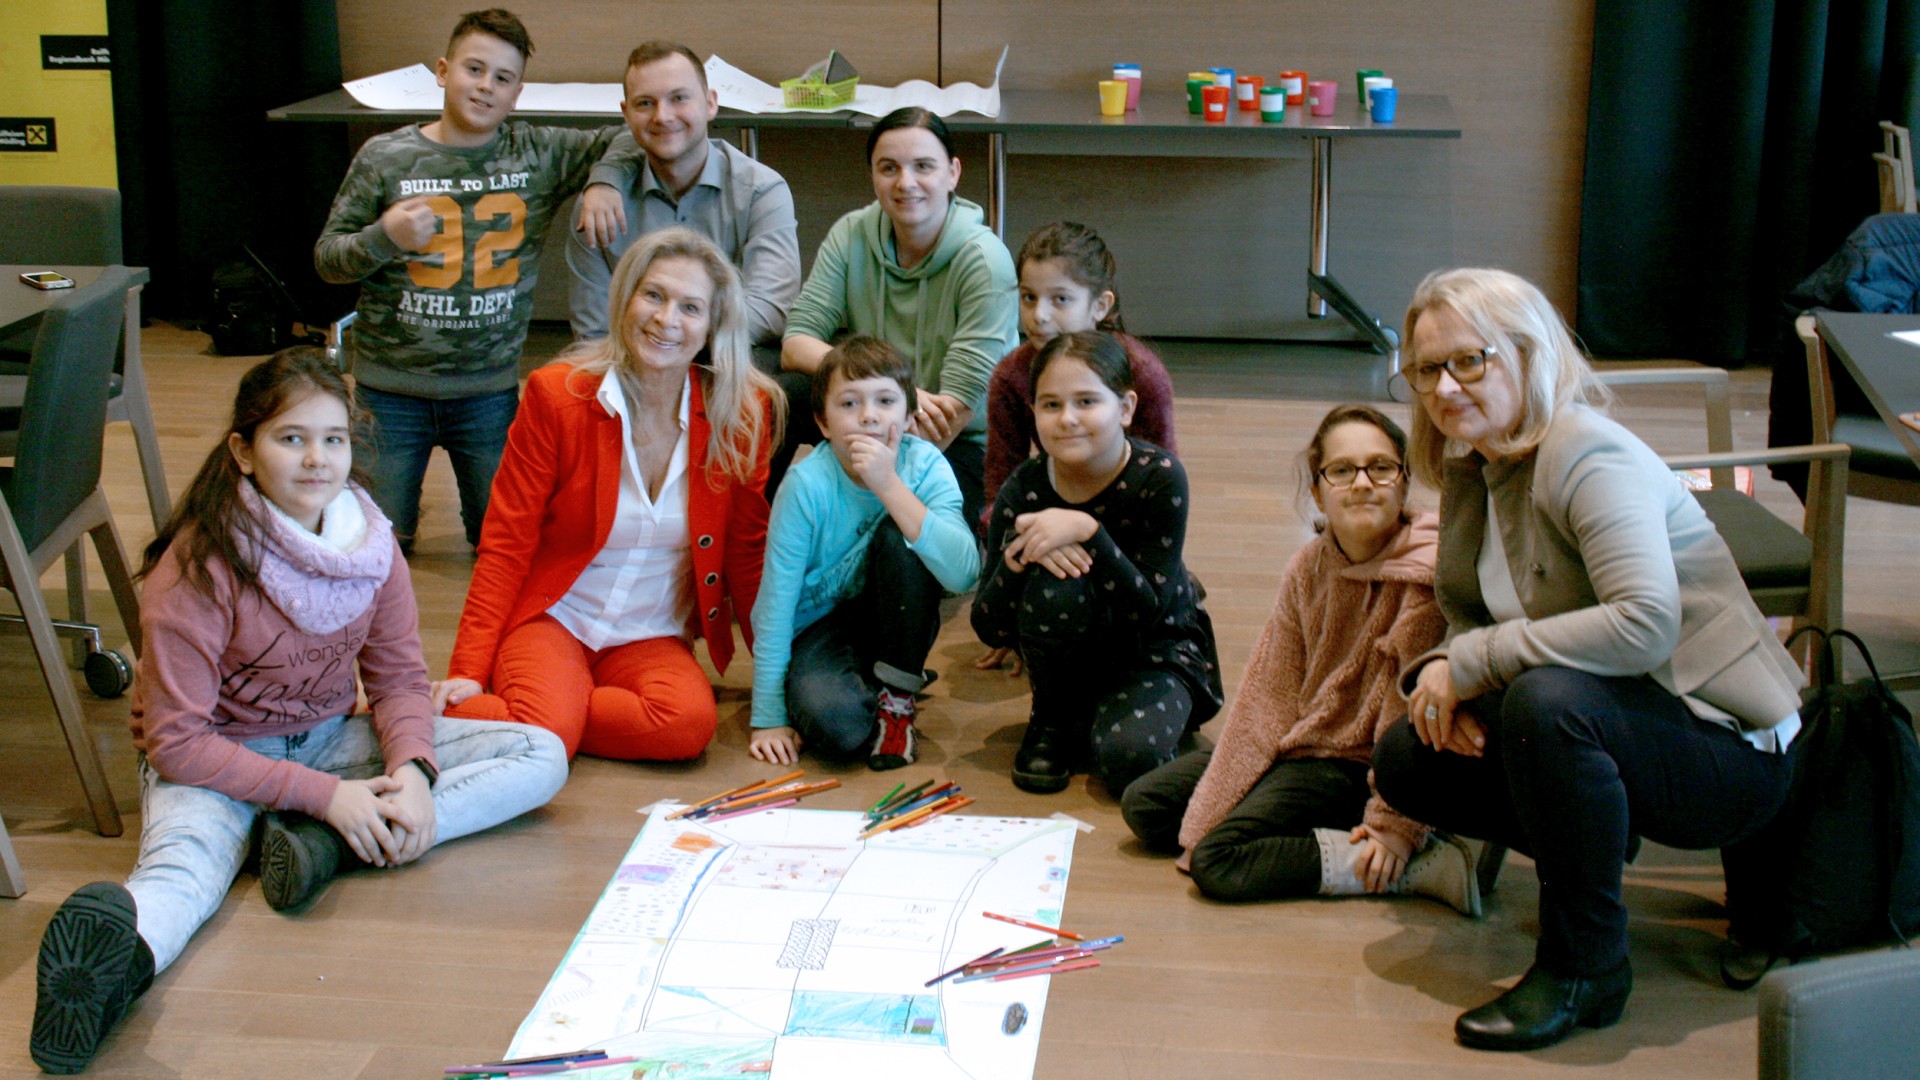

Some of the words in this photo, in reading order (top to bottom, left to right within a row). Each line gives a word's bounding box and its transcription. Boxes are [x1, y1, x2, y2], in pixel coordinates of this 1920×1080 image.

[400, 178, 453, 195] BUILT
[460, 178, 484, 192] TO
[488, 172, 529, 190] LAST
[398, 192, 527, 289] 92
[398, 290, 460, 316] ATHL
[469, 289, 516, 316] DEPT
[396, 313, 417, 326] THE
[423, 318, 480, 329] ORIGINAL
